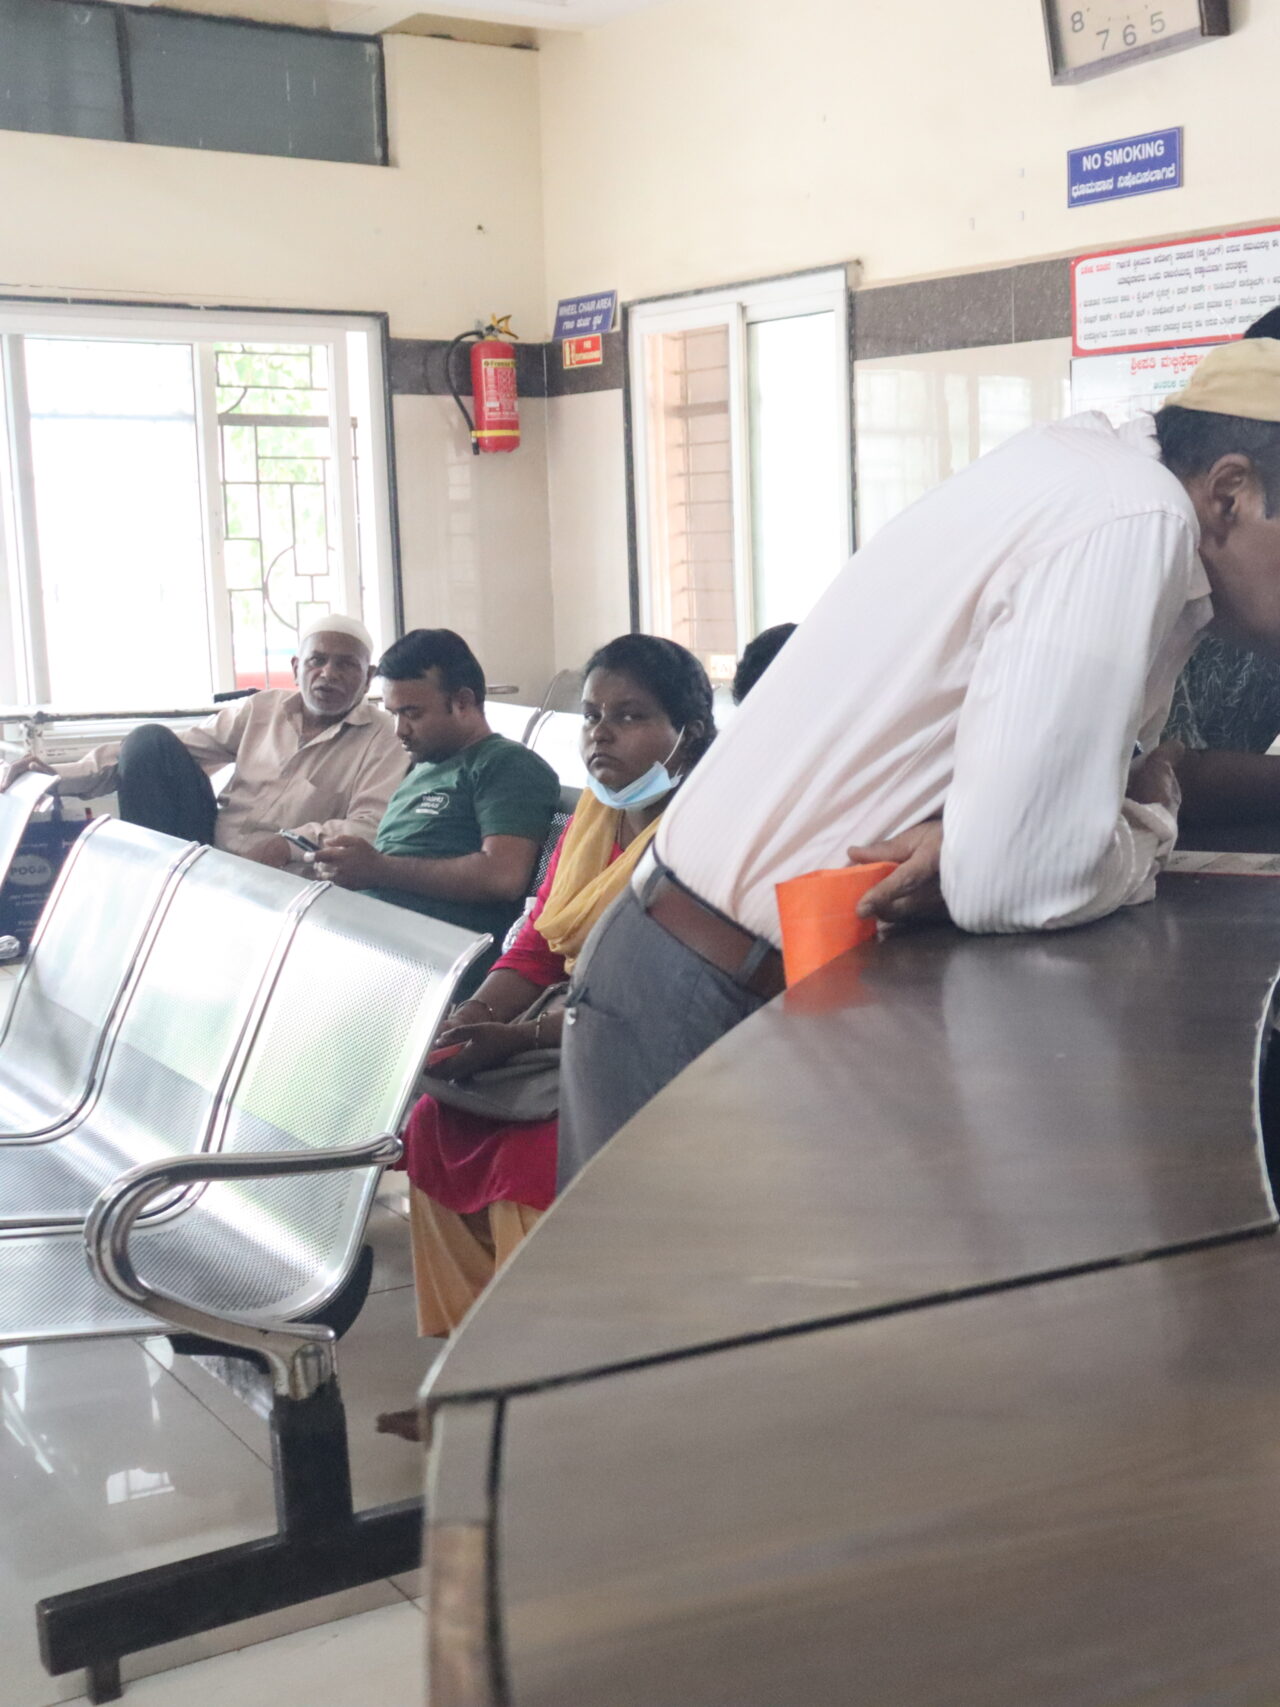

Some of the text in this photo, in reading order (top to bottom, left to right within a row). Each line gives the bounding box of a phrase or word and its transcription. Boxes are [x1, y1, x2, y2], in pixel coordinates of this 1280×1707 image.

[1071, 11, 1165, 51] 8 7 6 5
[1082, 140, 1165, 171] NO SMOKING
[559, 297, 612, 317] WHEEL CHAIR AREA
